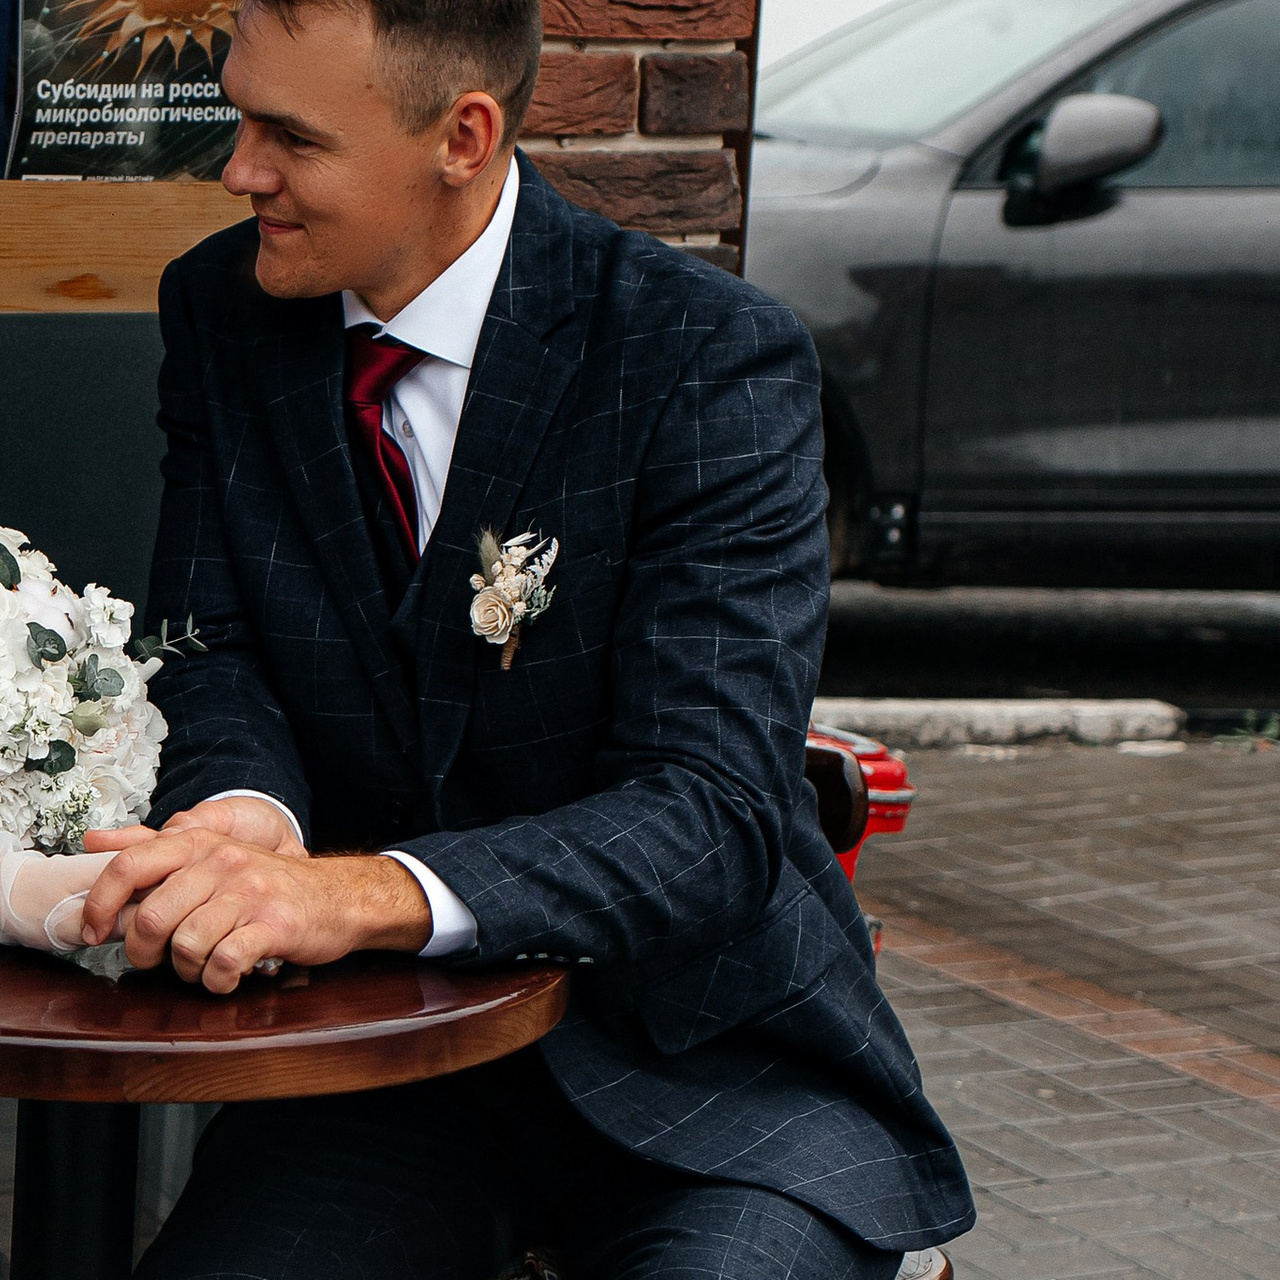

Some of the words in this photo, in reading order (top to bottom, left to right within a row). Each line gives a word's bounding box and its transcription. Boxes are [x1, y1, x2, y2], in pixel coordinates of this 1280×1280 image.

[36, 78, 136, 104] Субсидии
[140, 82, 165, 99] на
[30, 128, 146, 149] препараты
